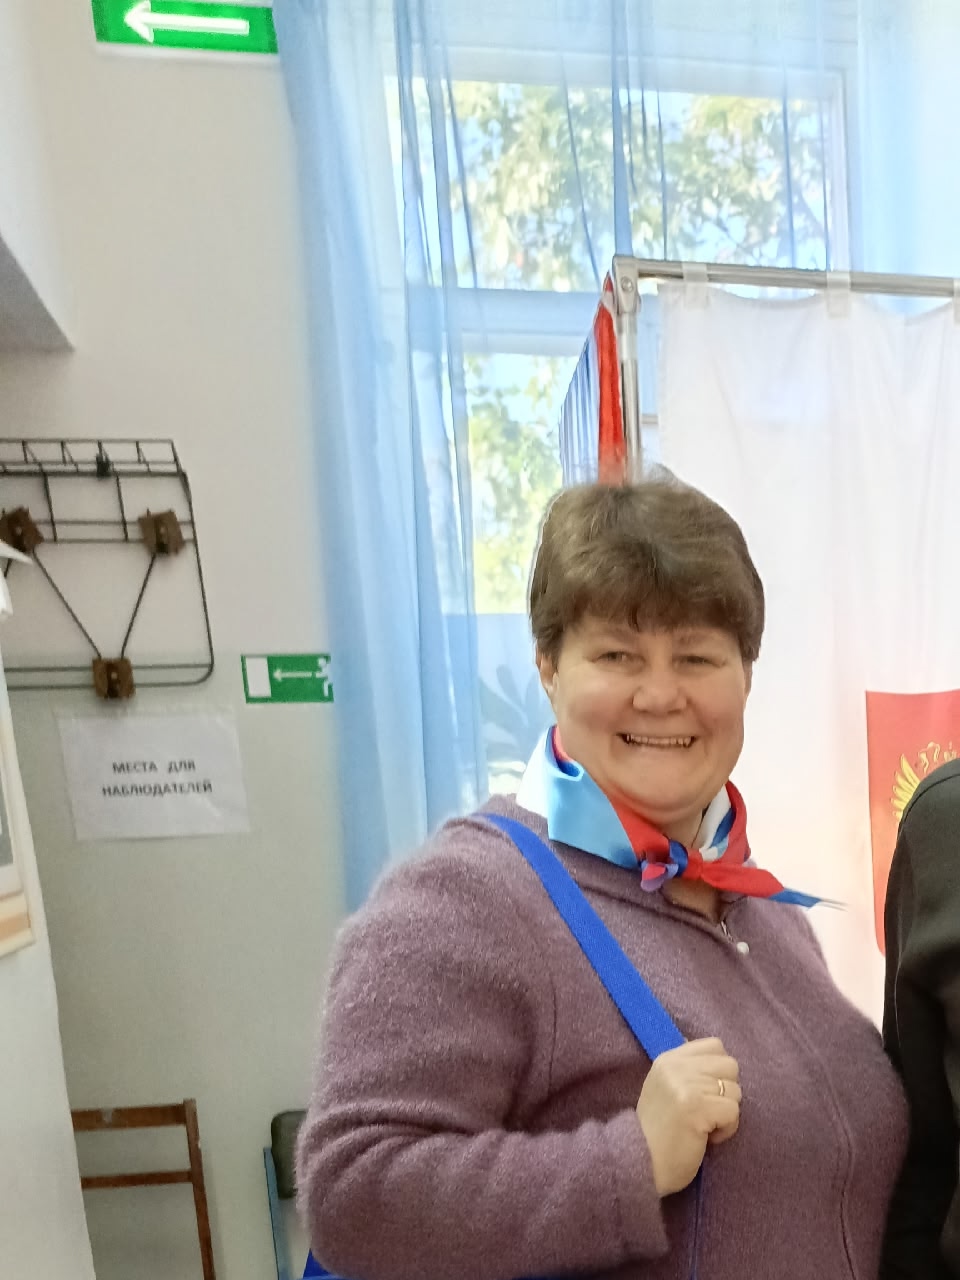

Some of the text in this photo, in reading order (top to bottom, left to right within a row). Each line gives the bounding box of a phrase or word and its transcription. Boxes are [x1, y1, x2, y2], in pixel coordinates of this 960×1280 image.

[112, 760, 196, 774] МЕСТА ДЛЯ
[102, 779, 213, 797] НАБЛЮДАТЕЛЕЙ
